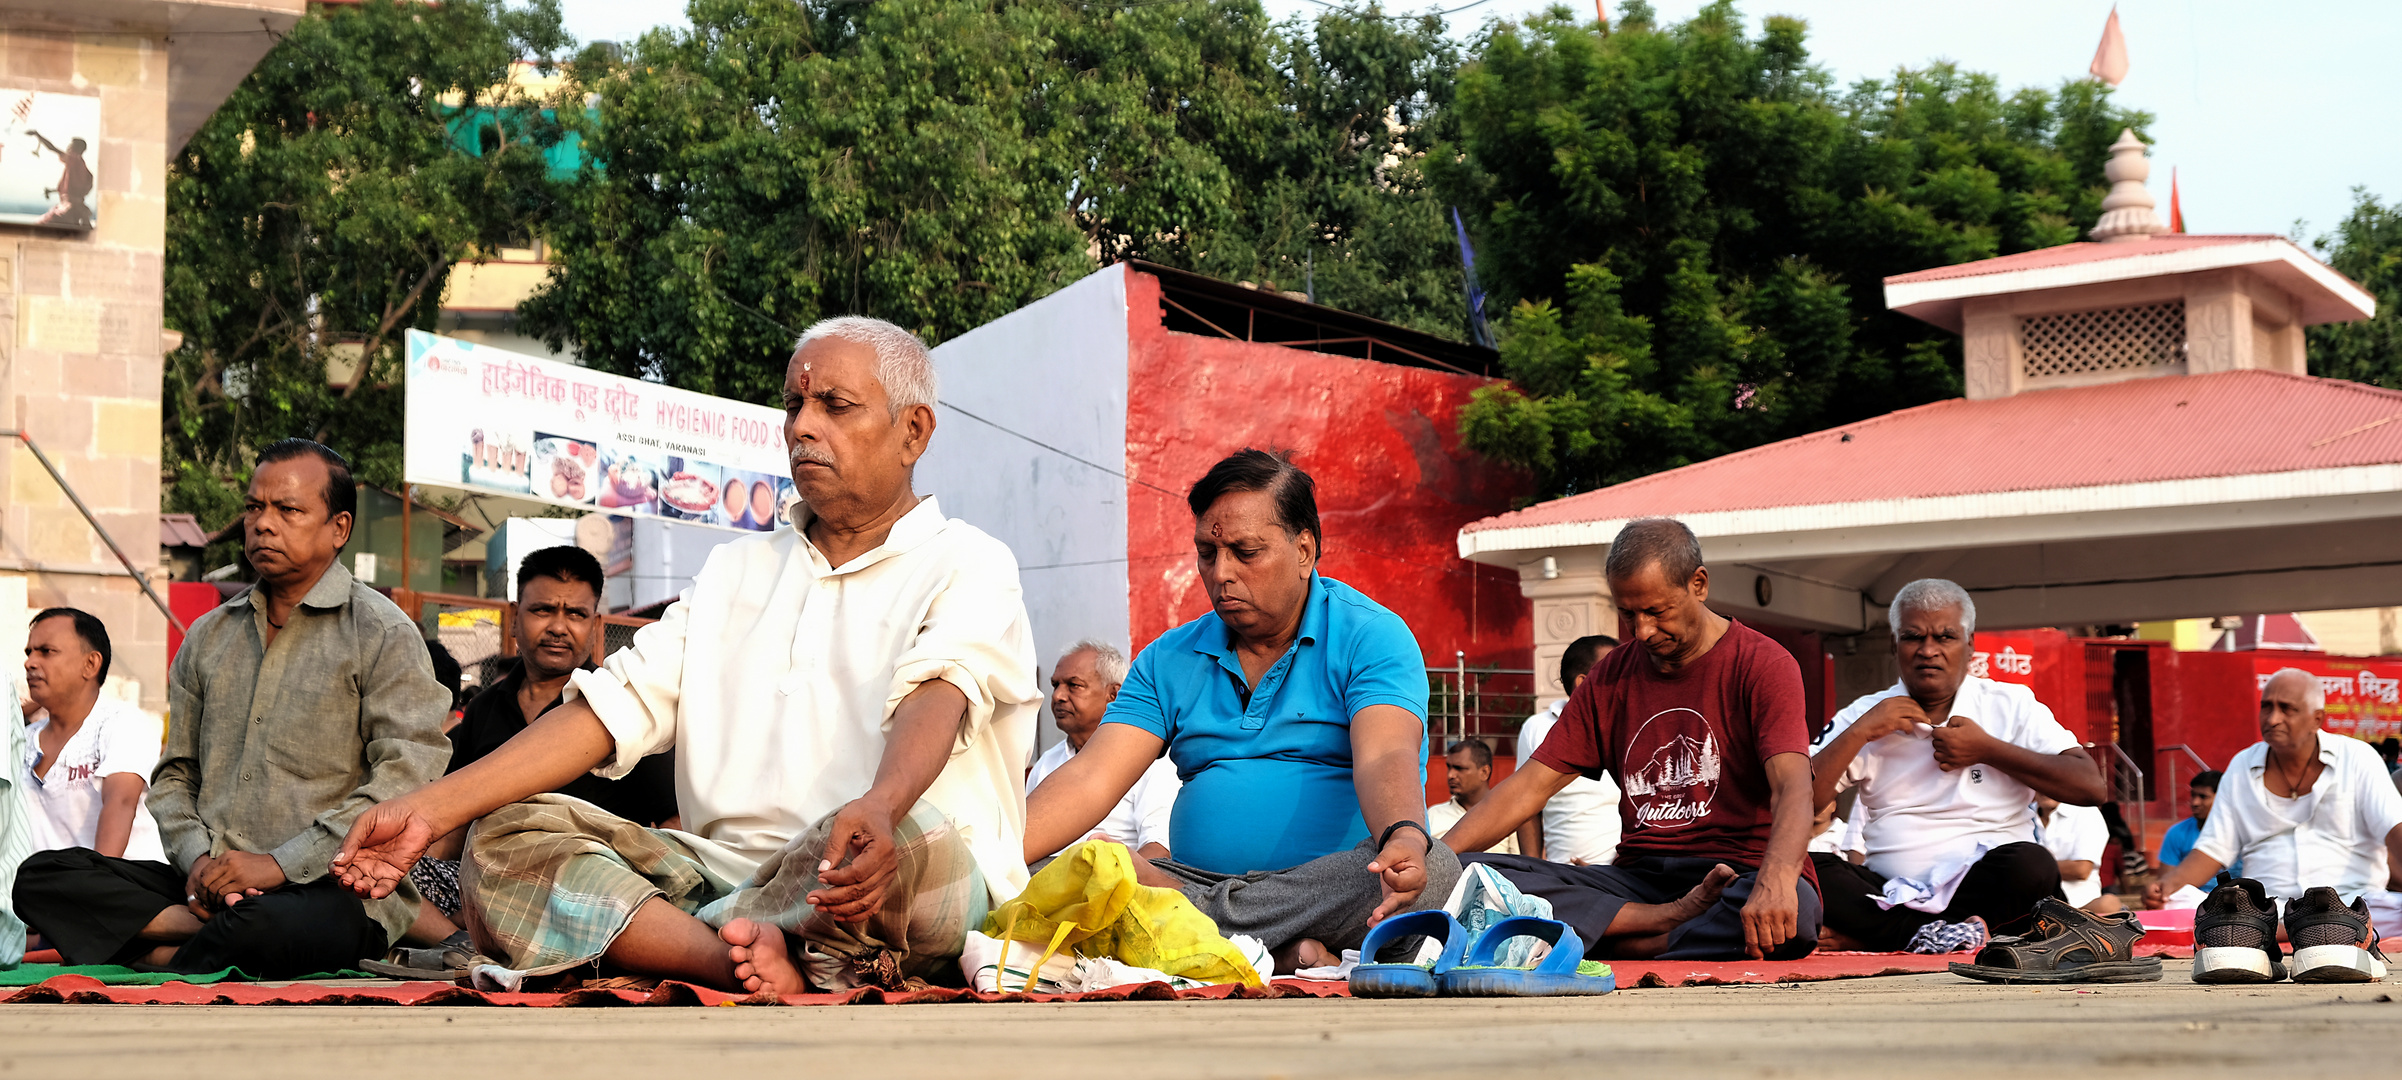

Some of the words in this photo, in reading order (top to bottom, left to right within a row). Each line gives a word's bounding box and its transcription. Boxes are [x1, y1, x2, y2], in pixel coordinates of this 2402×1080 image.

[482, 360, 567, 402] हाईजेनिक
[572, 381, 599, 422] फूड
[603, 383, 639, 424] स्ट्रीट
[656, 400, 726, 438] HYGIENIC
[732, 417, 768, 447] FOOD
[616, 432, 635, 443] ASSI
[638, 436, 661, 449] GHAT,
[665, 441, 706, 456] VARANASI
[1967, 651, 1990, 678] द्ध
[1995, 646, 2032, 675] पीठ
[1635, 799, 1711, 828] Outdoors
